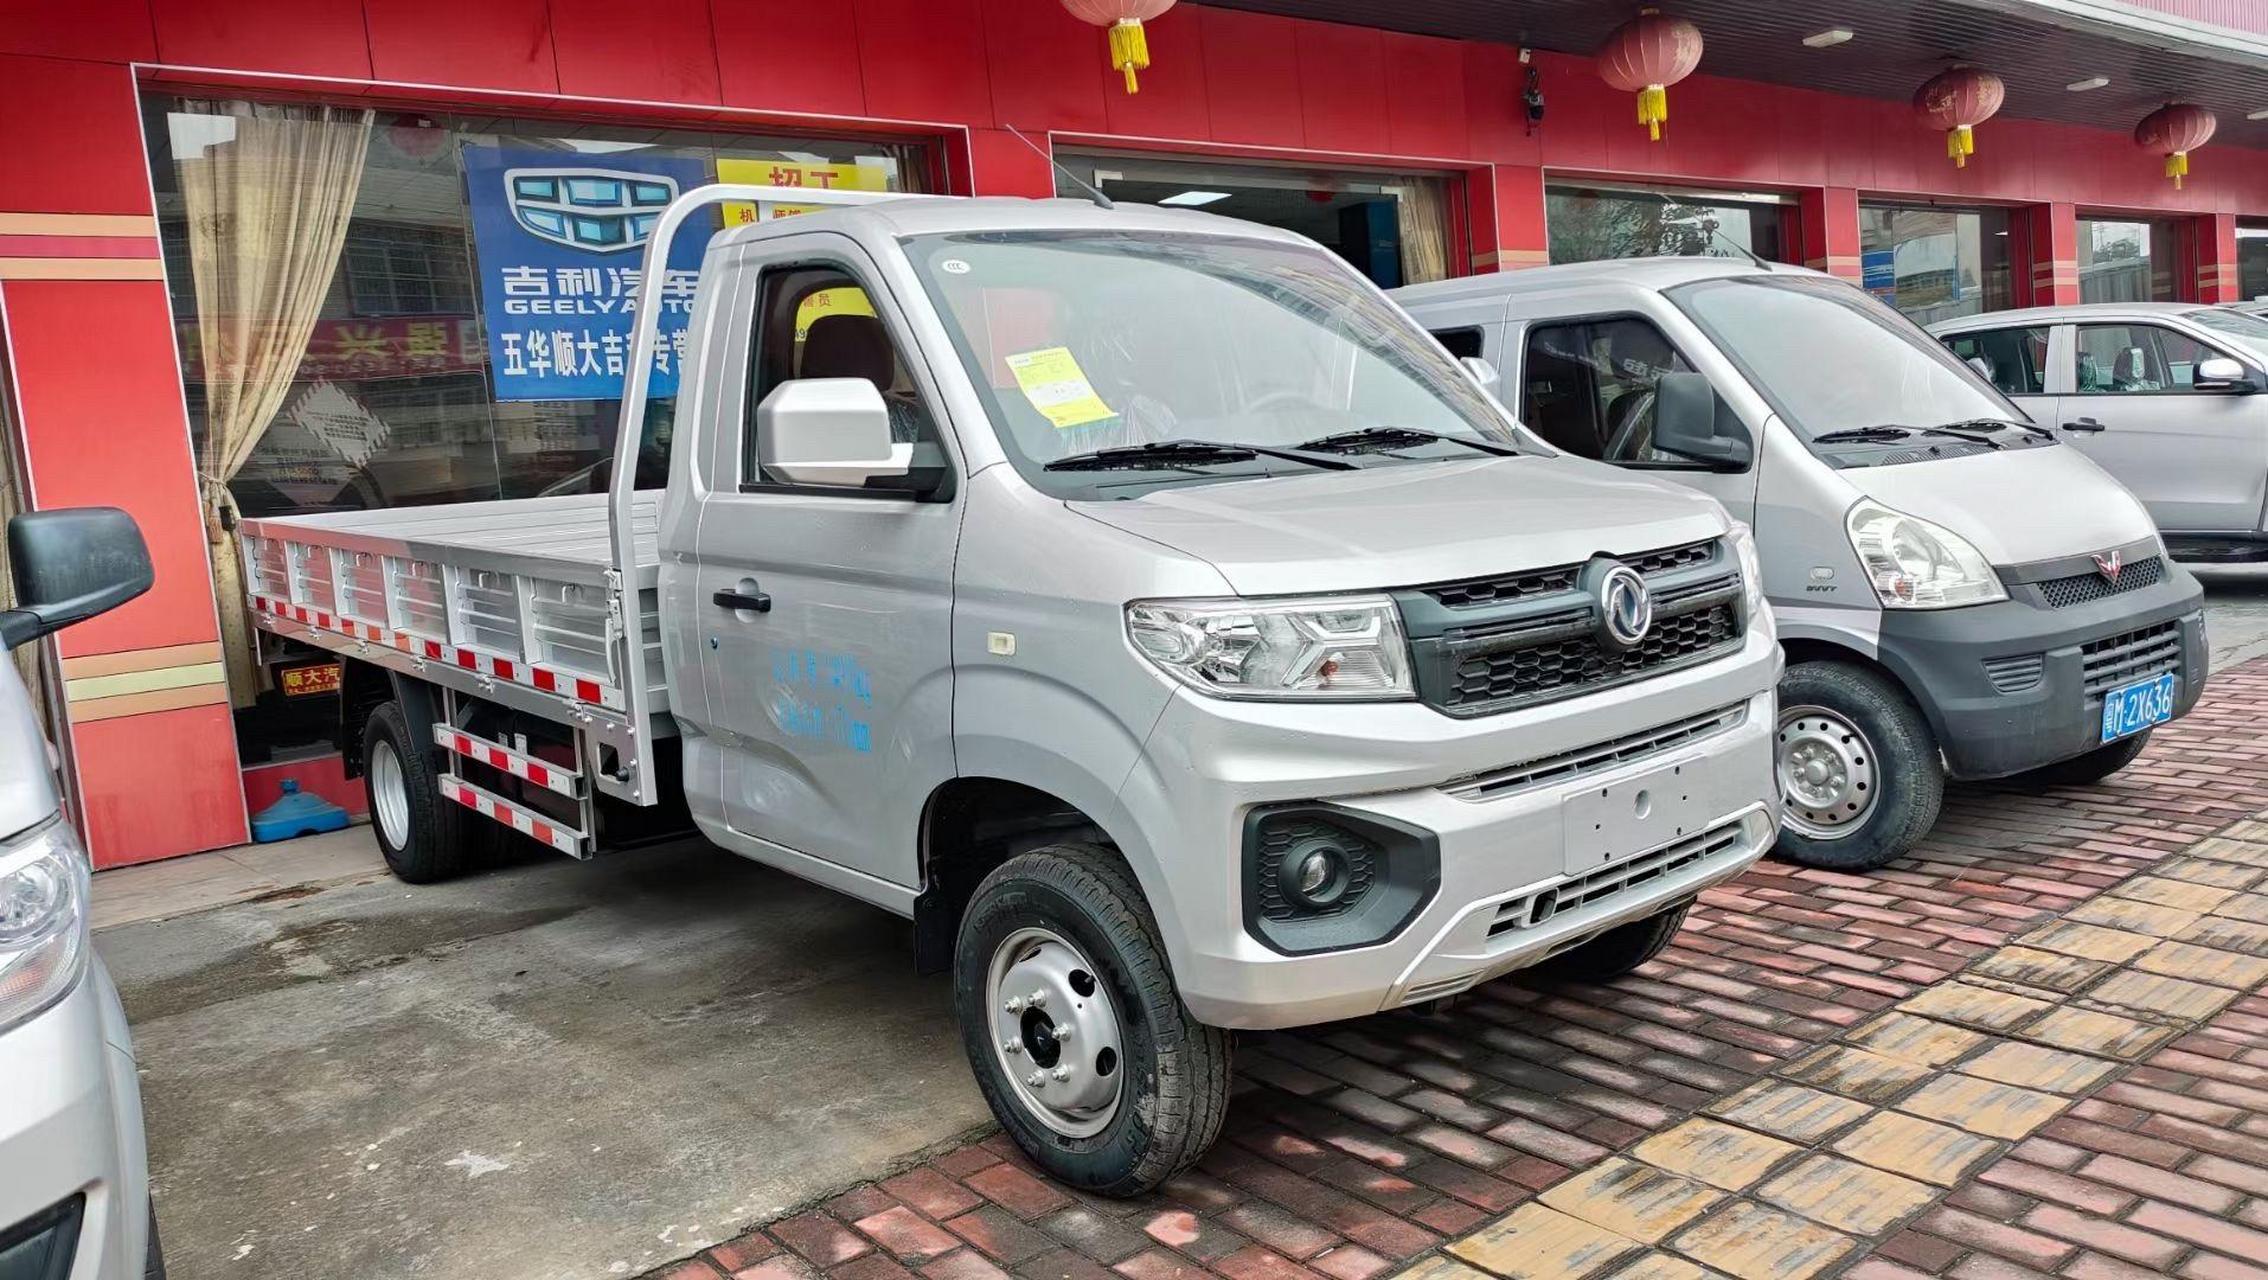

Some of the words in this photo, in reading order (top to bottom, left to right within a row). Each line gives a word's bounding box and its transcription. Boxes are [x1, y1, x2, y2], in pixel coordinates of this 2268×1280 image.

[501, 266, 699, 297] 吉利汽车
[620, 299, 694, 314] ATO
[501, 329, 688, 378] 五华顺大吉专营
